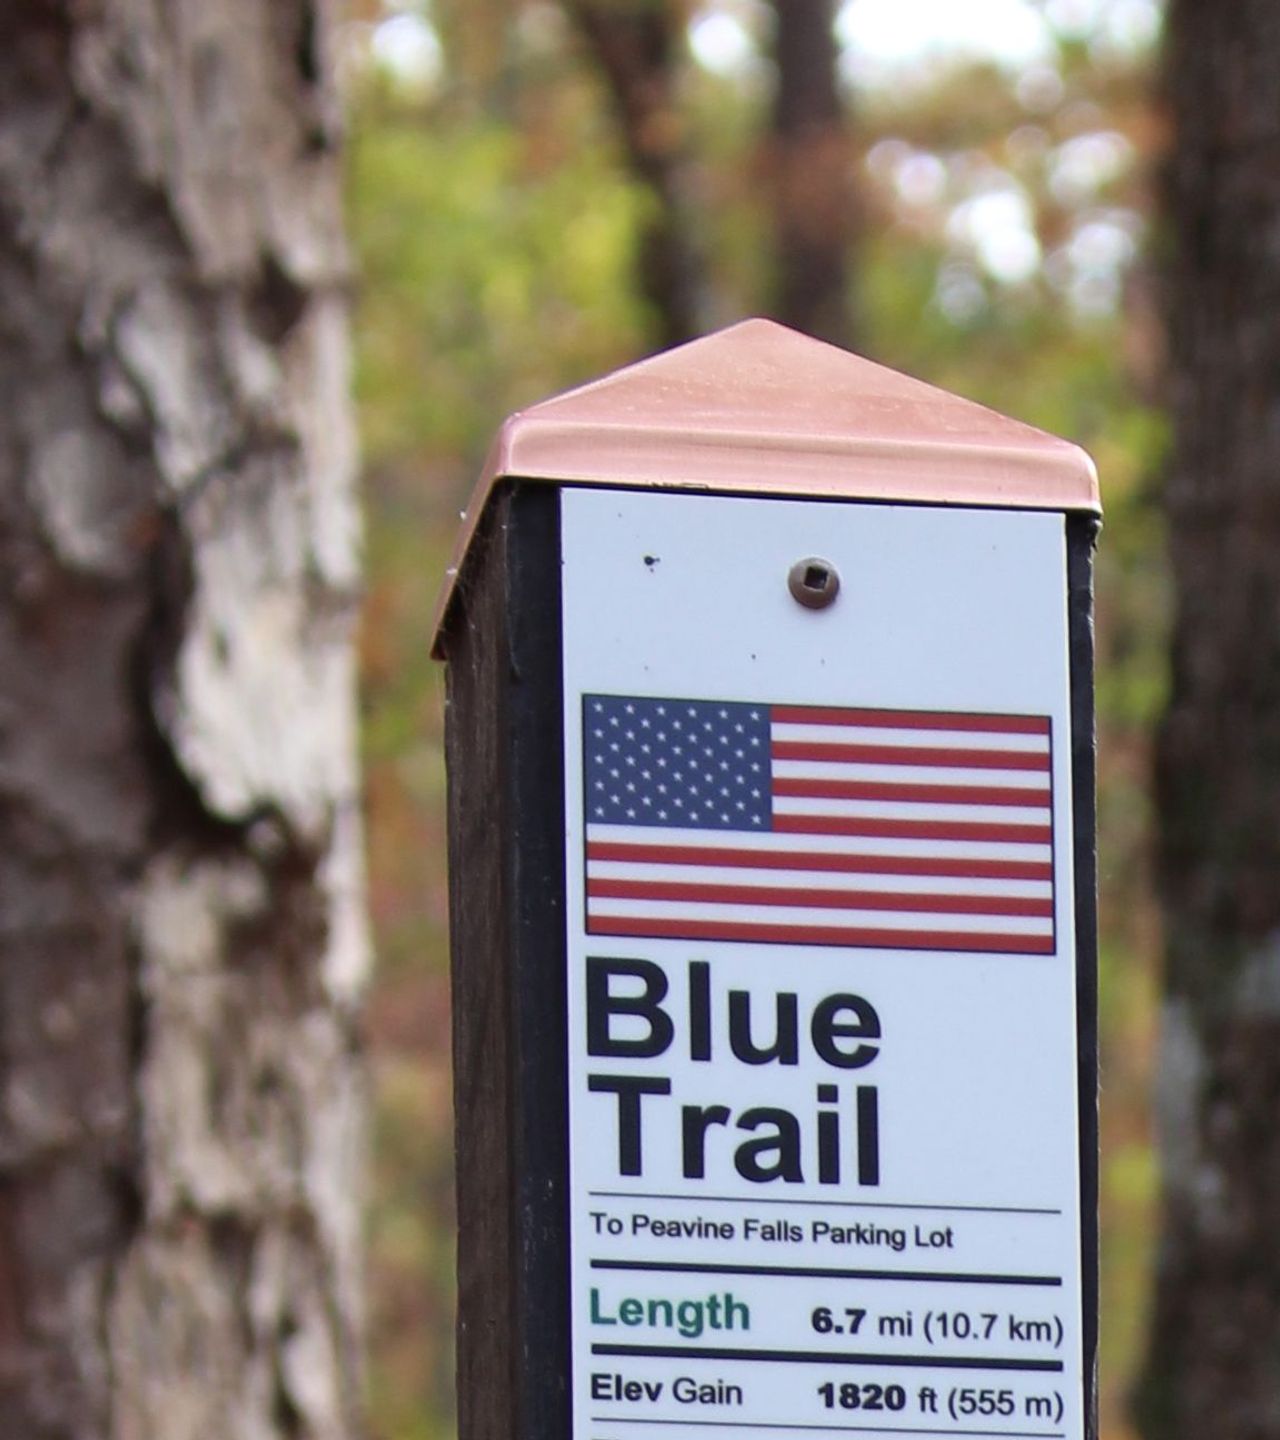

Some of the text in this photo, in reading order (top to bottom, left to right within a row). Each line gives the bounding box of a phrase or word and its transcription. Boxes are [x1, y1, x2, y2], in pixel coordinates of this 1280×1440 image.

[585, 955, 882, 1071] Blue
[586, 1073, 880, 1187] Trail
[588, 1211, 954, 1251] To Peavine Falls Parking Lot
[589, 1287, 1064, 1349] Length 6.7 mi (10.7 km)
[590, 1372, 1064, 1425] Elev Gain 1820 ft (555 m)
